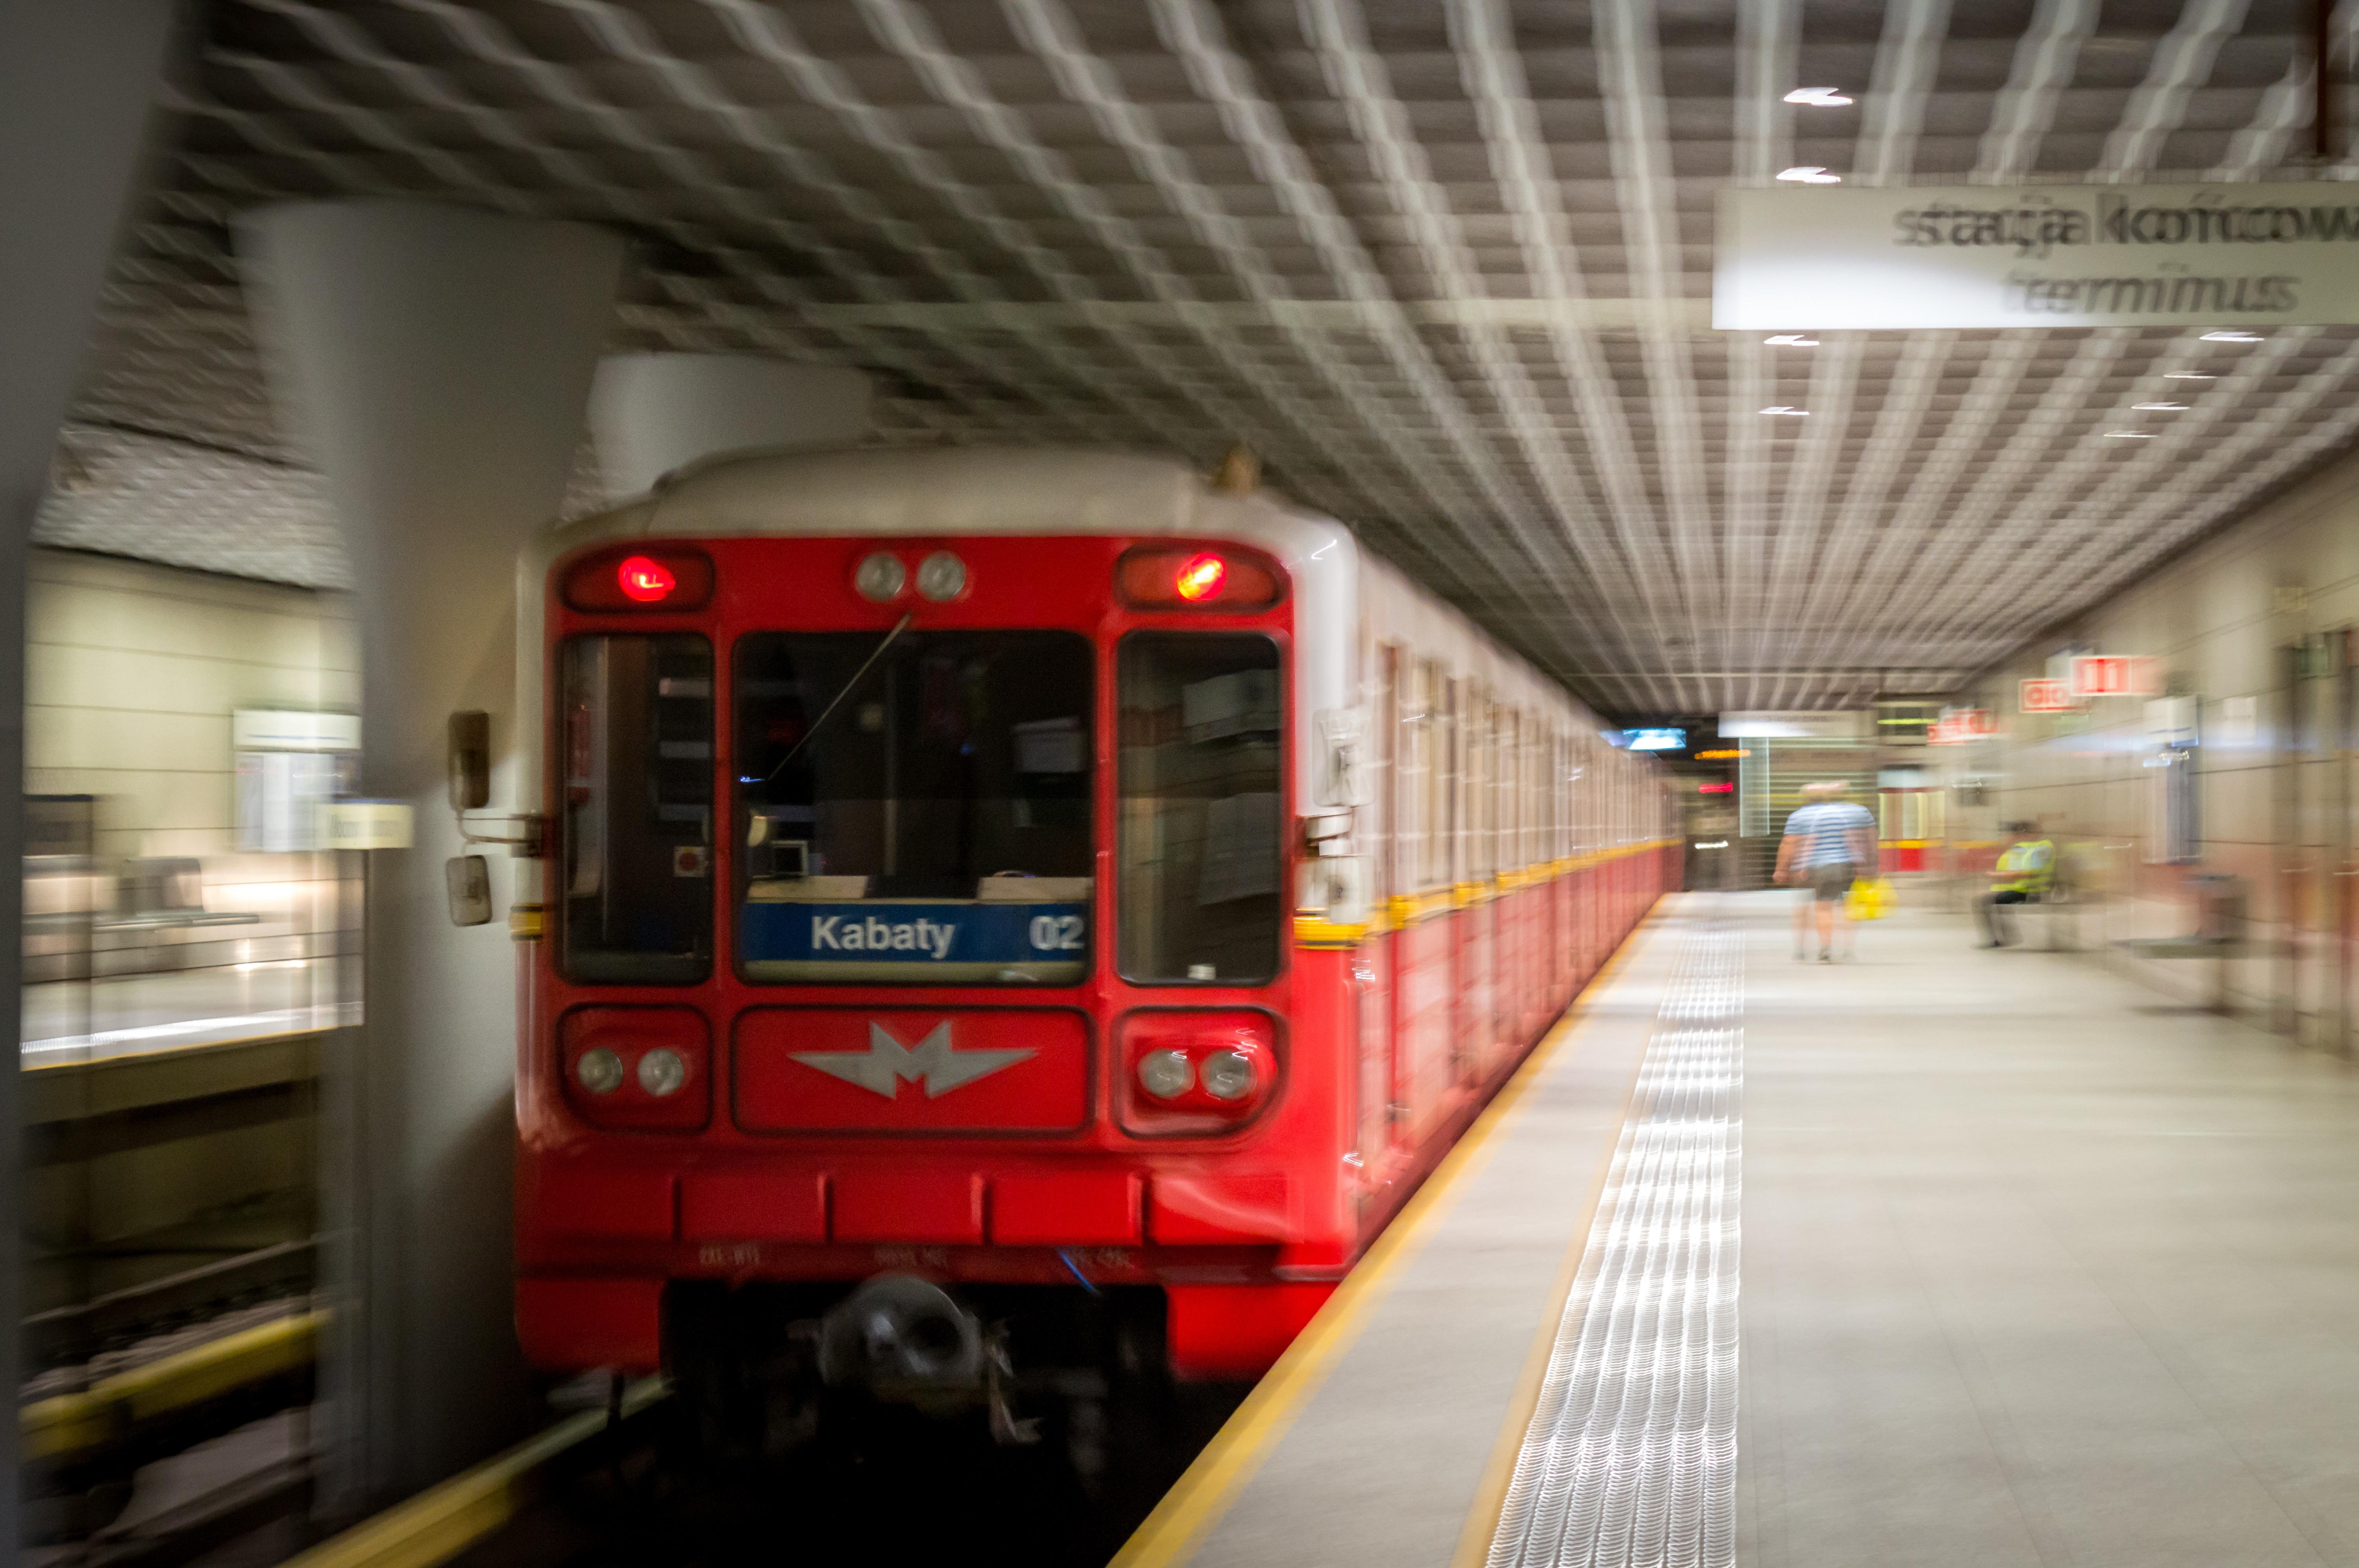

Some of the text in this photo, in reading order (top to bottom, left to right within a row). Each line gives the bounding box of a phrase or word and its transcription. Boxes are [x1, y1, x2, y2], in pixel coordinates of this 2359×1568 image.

[1892, 191, 2359, 260] stacja końcow
[2001, 263, 2301, 314] terminus
[812, 915, 1085, 958] Kabaty 02
